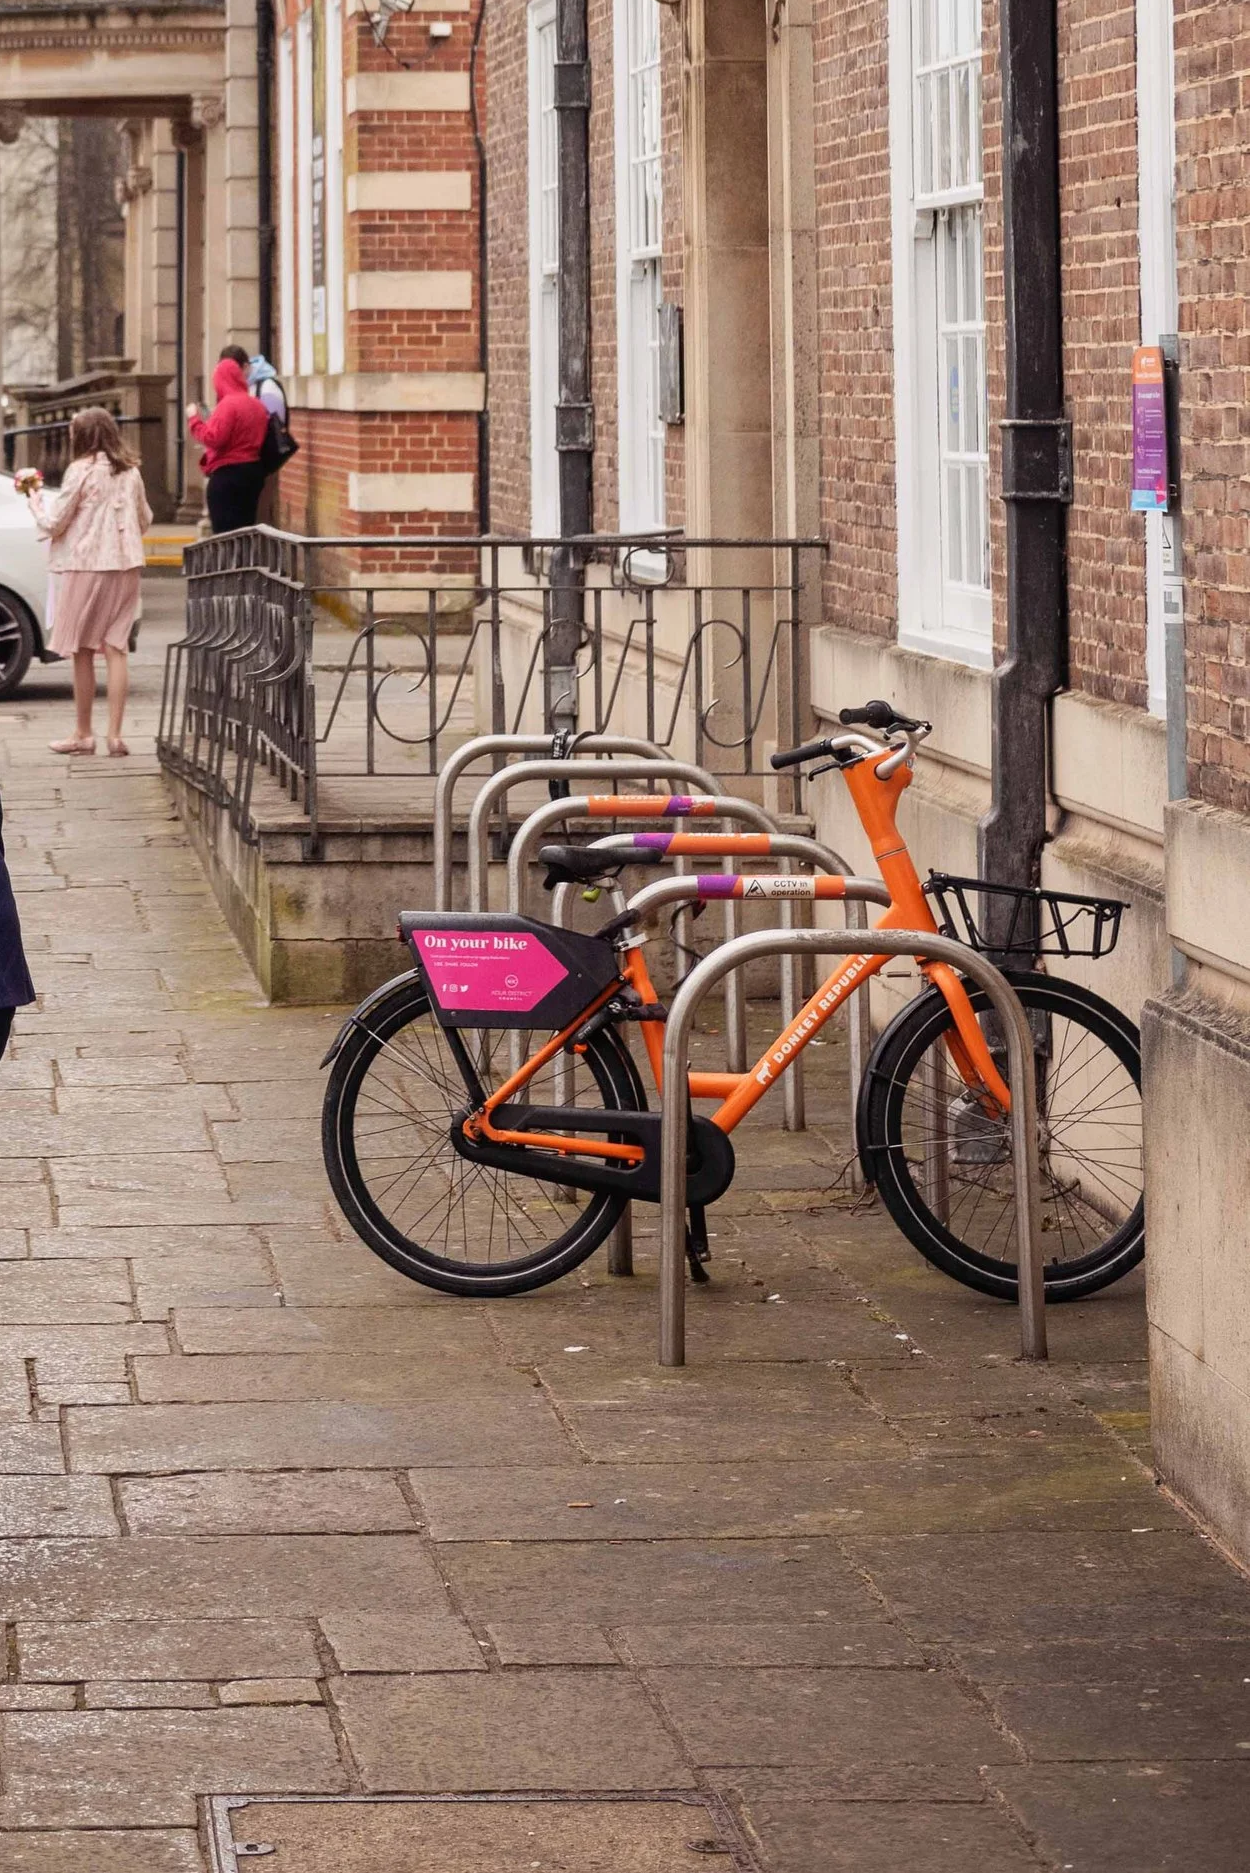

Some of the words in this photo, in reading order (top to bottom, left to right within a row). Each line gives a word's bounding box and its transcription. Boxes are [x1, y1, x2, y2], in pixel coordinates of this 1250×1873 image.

[773, 880, 798, 888] CCTV
[771, 888, 811, 897] operation
[424, 935, 447, 948] On
[451, 937, 489, 951] your
[493, 936, 528, 950] bike
[773, 1009, 820, 1064] DONKEY
